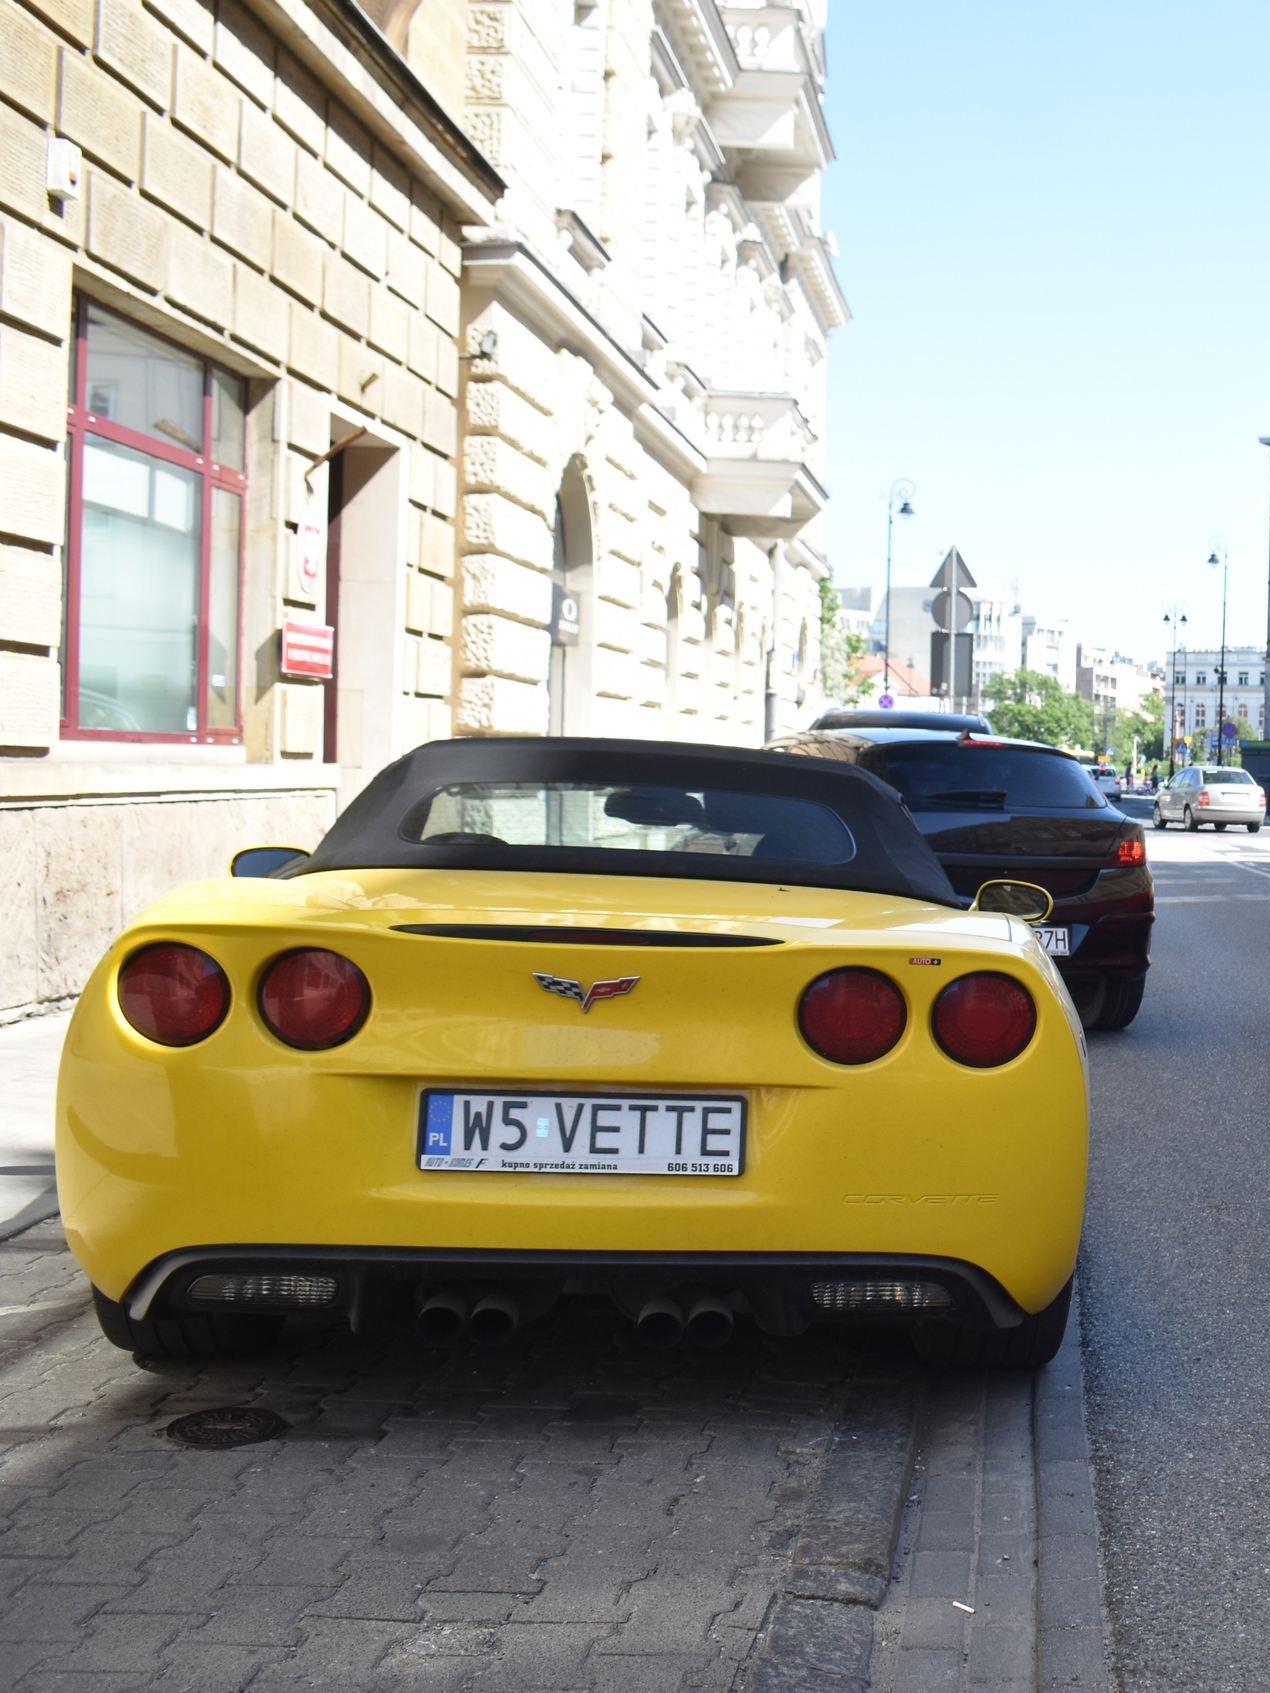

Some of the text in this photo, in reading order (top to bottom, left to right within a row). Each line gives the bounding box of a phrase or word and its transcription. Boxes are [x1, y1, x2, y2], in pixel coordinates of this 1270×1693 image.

[1222, 737, 1236, 745] TAXI
[463, 1100, 733, 1157] W5 VETTE
[428, 1132, 448, 1147] PL
[501, 1159, 531, 1170] kupno
[533, 1161, 576, 1170] sprzedaż
[578, 1162, 618, 1170] zamiana
[667, 1162, 688, 1172] 606
[691, 1163, 709, 1172] 513
[712, 1164, 734, 1173] 606
